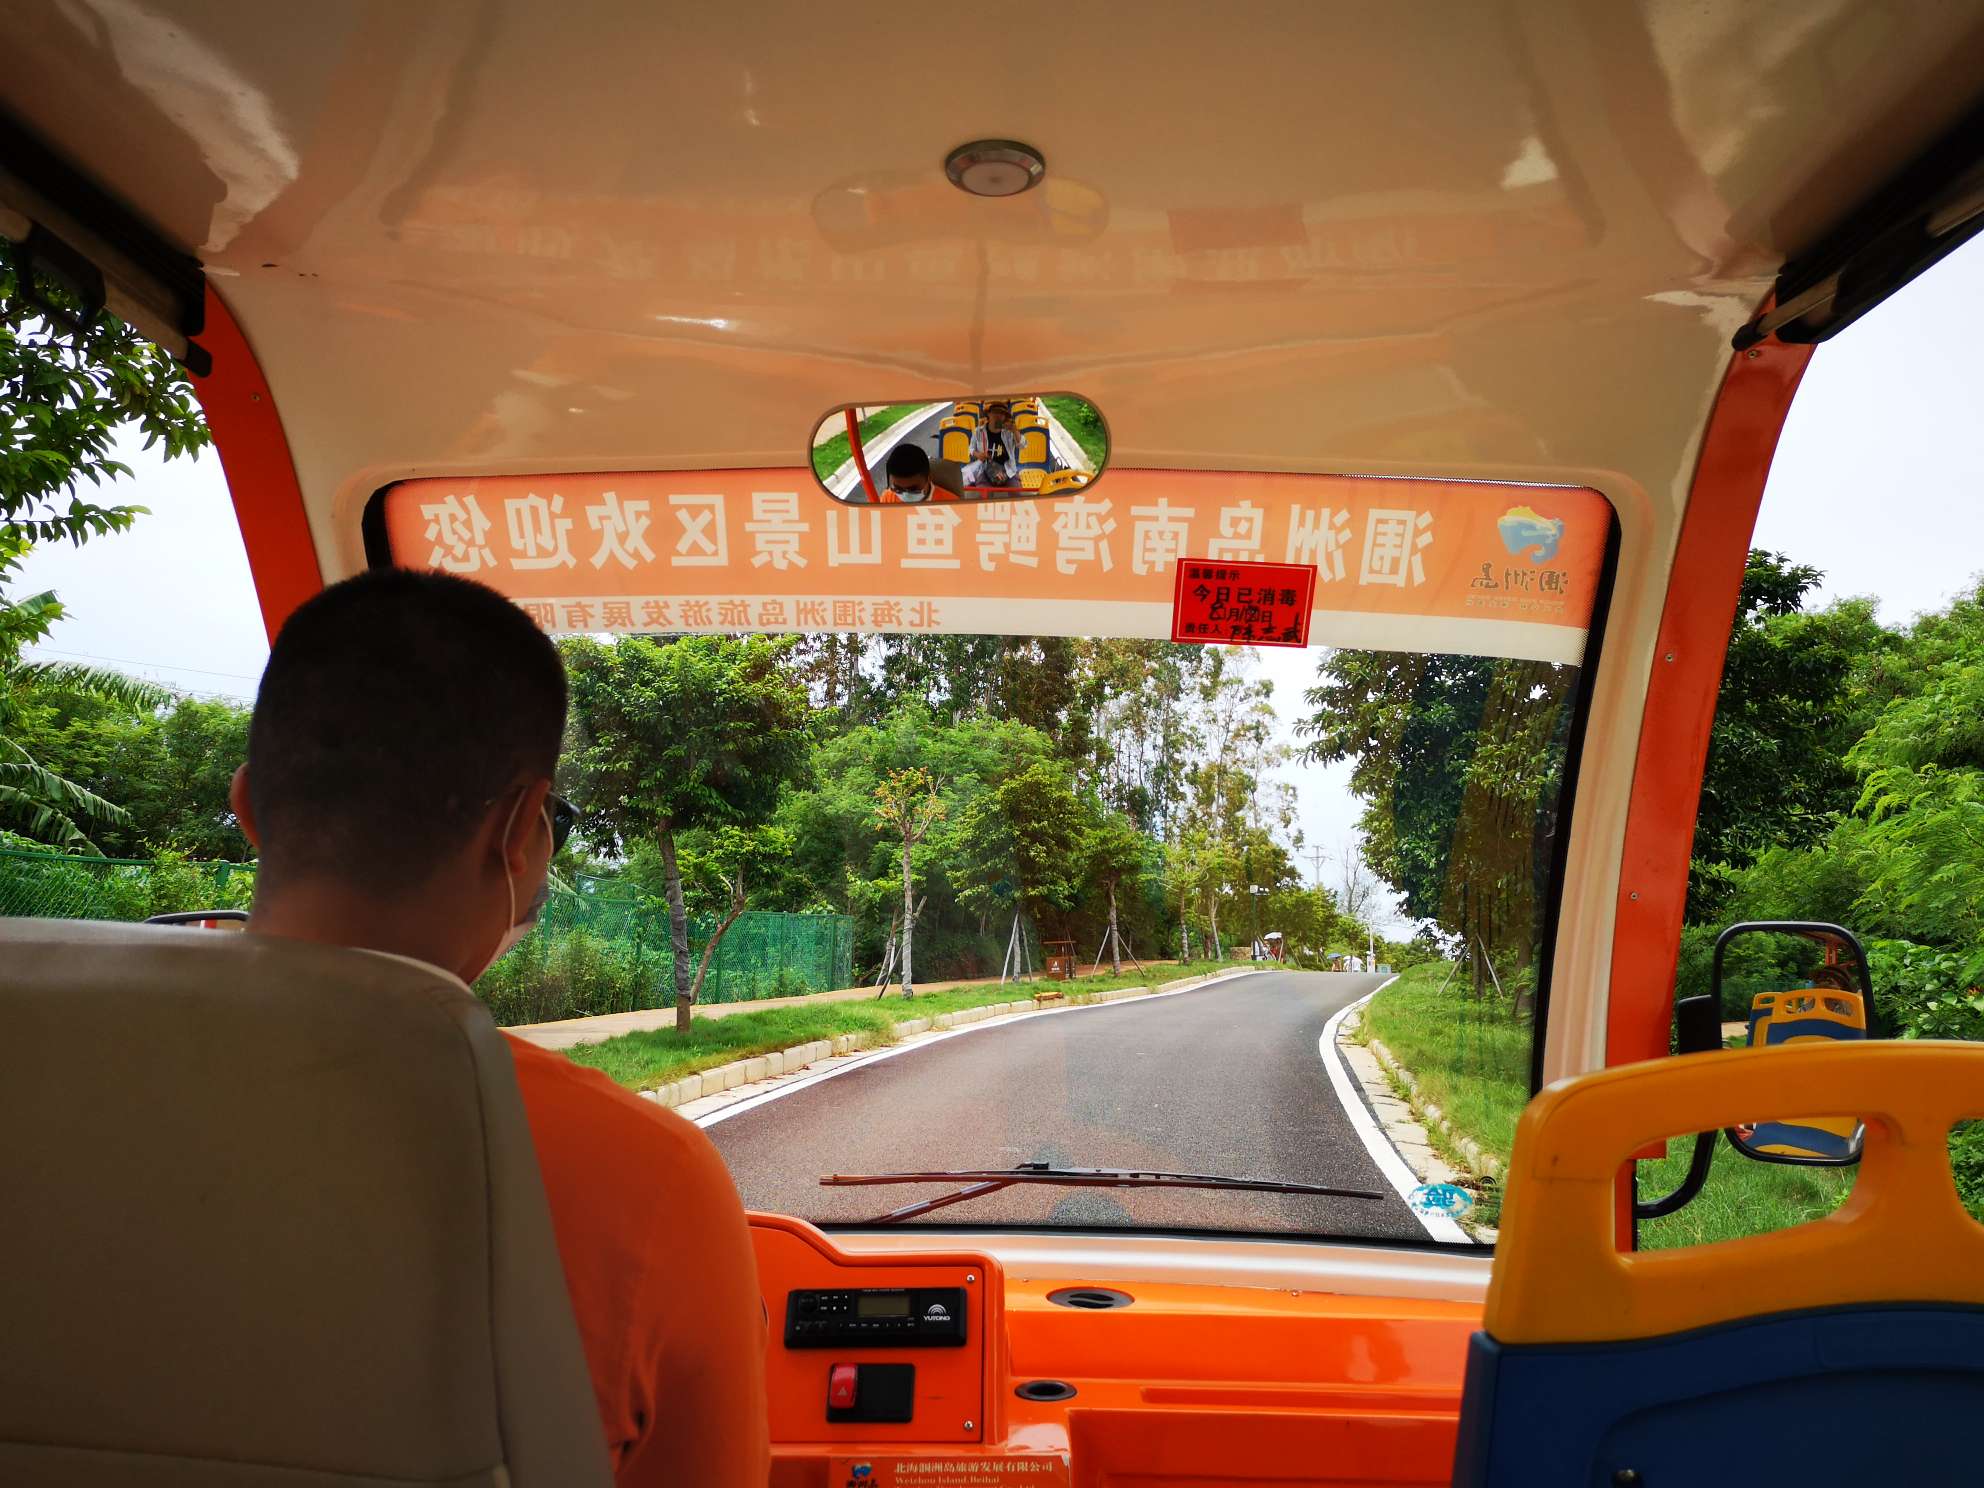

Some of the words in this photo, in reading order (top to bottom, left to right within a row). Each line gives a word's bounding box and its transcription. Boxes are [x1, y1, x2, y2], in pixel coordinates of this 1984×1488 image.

[1192, 583, 1297, 606] 今日已消毒
[895, 1462, 1053, 1473] 北海涠洲岛旅游发展有限公司
